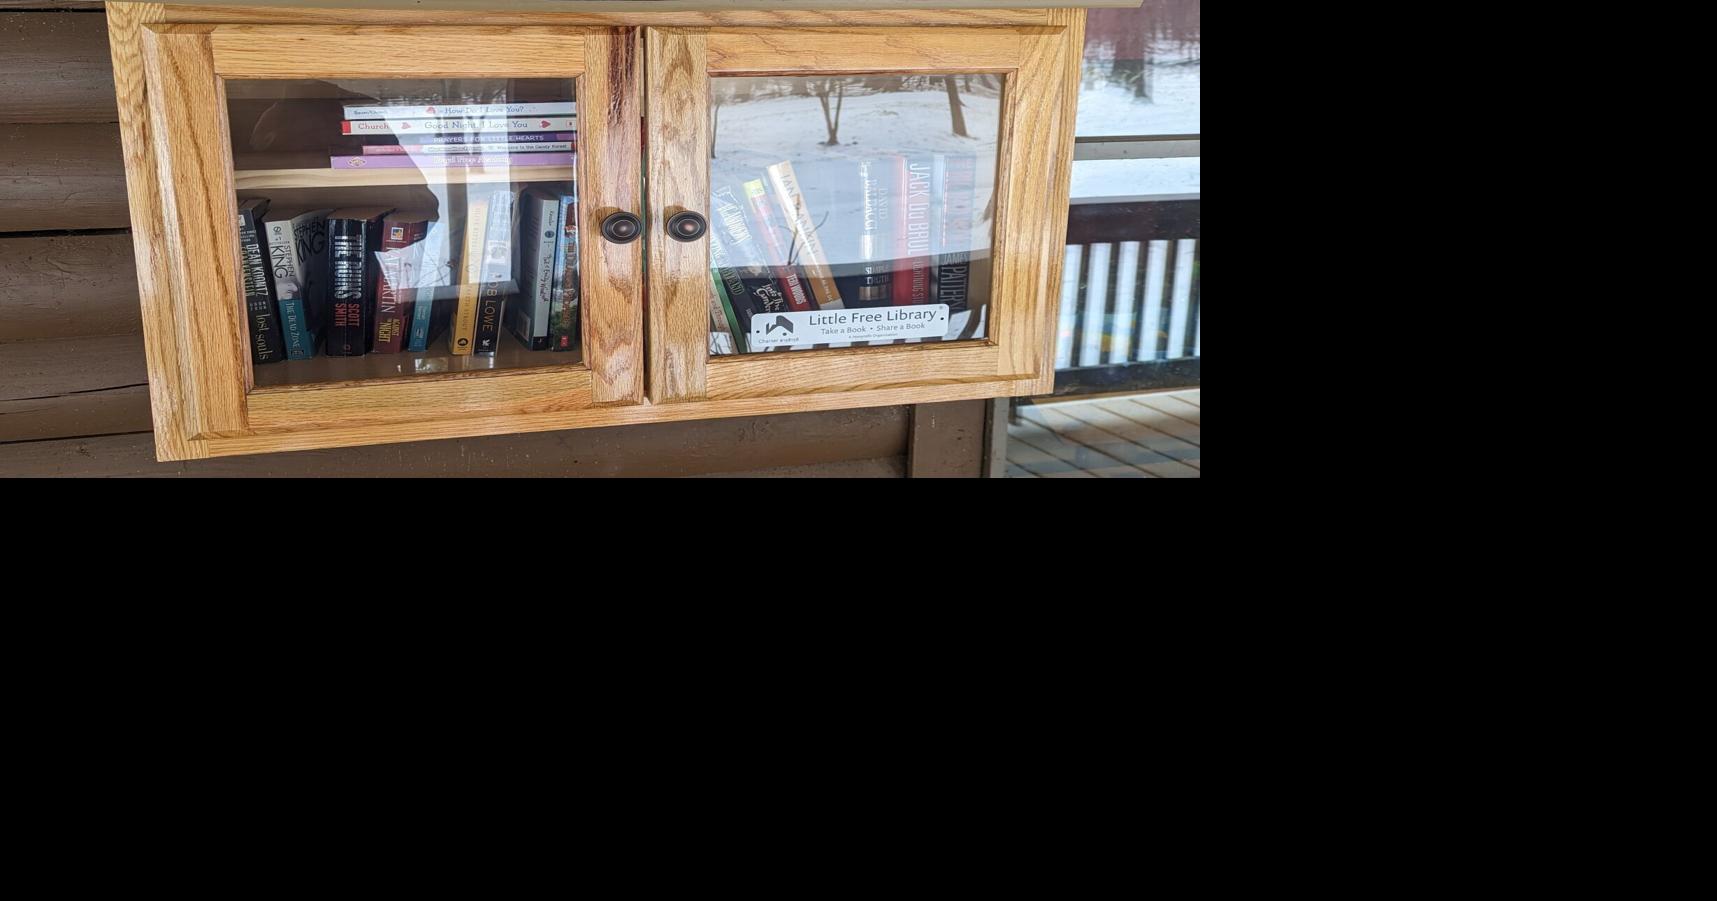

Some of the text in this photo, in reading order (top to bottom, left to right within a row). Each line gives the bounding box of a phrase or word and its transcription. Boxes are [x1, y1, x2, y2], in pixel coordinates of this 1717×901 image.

[424, 121, 448, 130] Good
[488, 120, 508, 128] Love
[512, 120, 528, 128] You
[909, 163, 930, 198] JACK
[907, 222, 929, 256] BRUL
[246, 244, 262, 265] DEAN
[270, 245, 288, 279] KING
[284, 245, 295, 277] STEPHEN
[334, 234, 362, 298] THE RUINS
[251, 266, 268, 296] KOONTZ
[381, 270, 398, 313] MARTIN
[286, 302, 295, 313] THE
[336, 303, 347, 327] SMITH
[348, 303, 360, 327] SCOTT
[482, 300, 496, 332] LOWE
[809, 310, 937, 326] Little Free Library
[288, 315, 297, 331] DEAD
[378, 322, 392, 343] NIGHT
[820, 326, 840, 336] Take
[876, 324, 898, 332] Share
[256, 313, 273, 360] lost souls
[290, 331, 300, 348] ZONE
